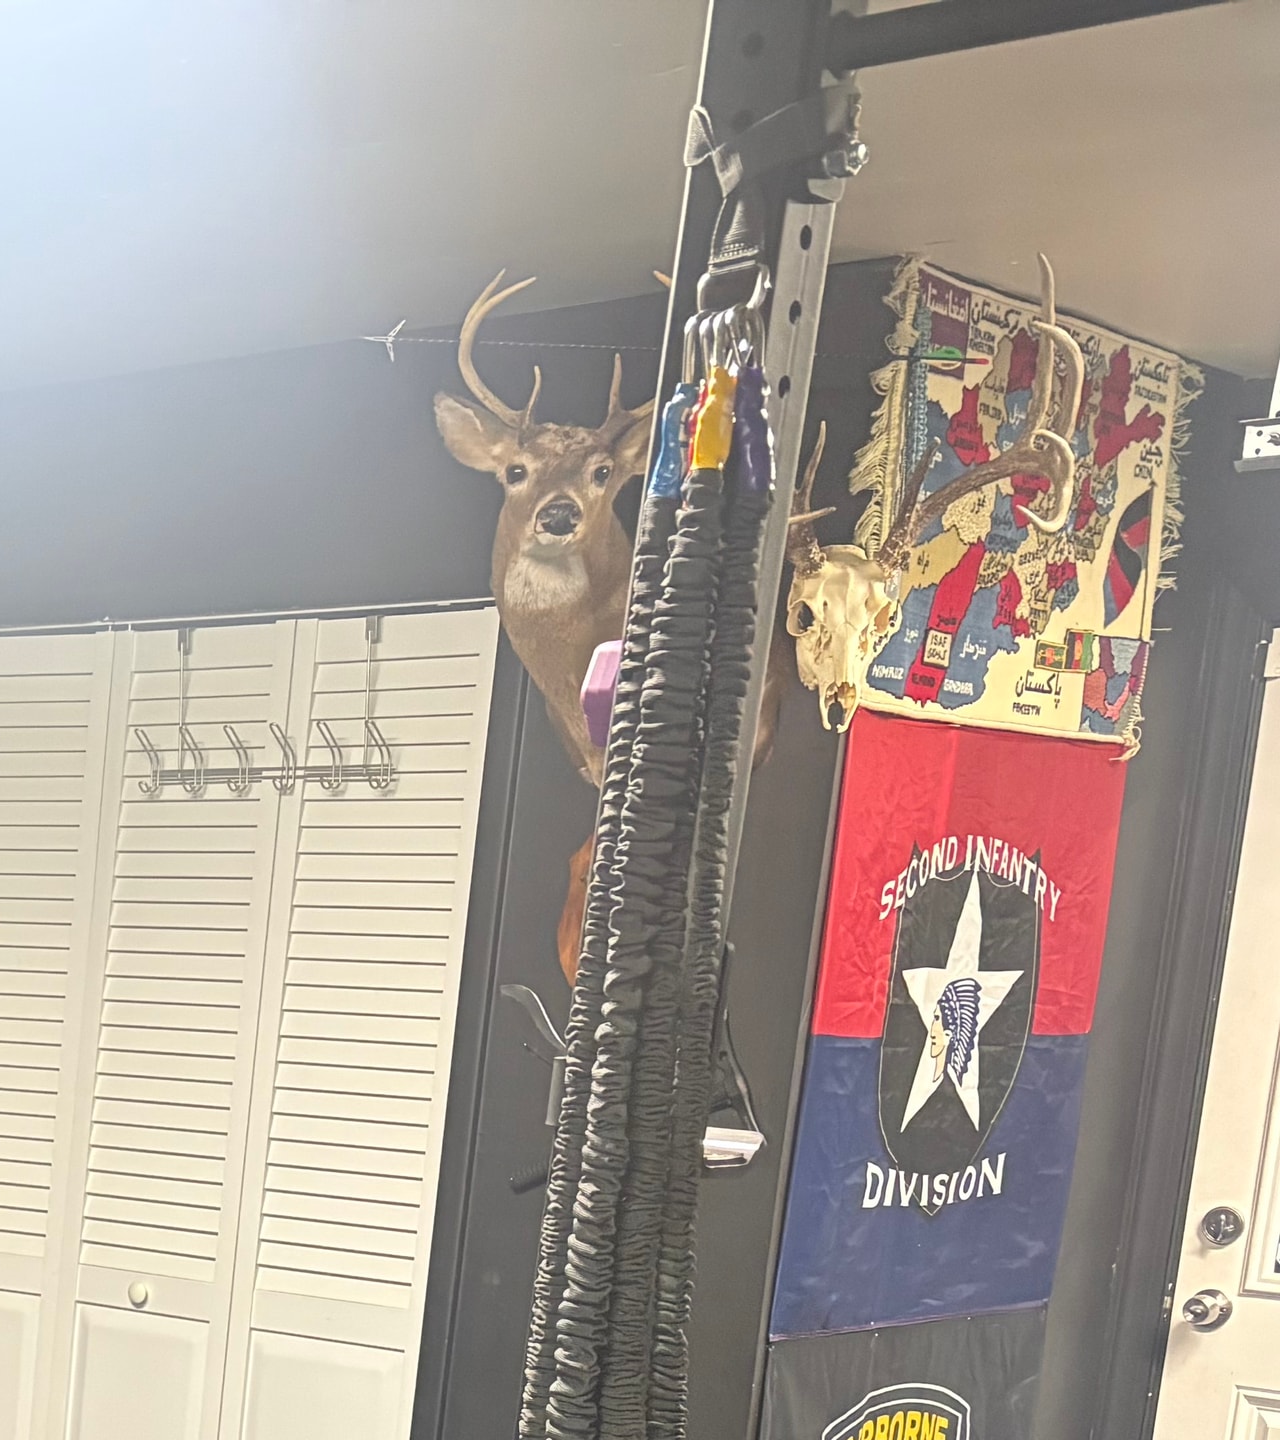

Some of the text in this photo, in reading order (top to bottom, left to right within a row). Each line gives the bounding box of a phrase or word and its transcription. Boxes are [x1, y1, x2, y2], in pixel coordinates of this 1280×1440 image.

[879, 835, 1061, 922] SECOND INFANTRY
[862, 1153, 1007, 1209] DIVISION
